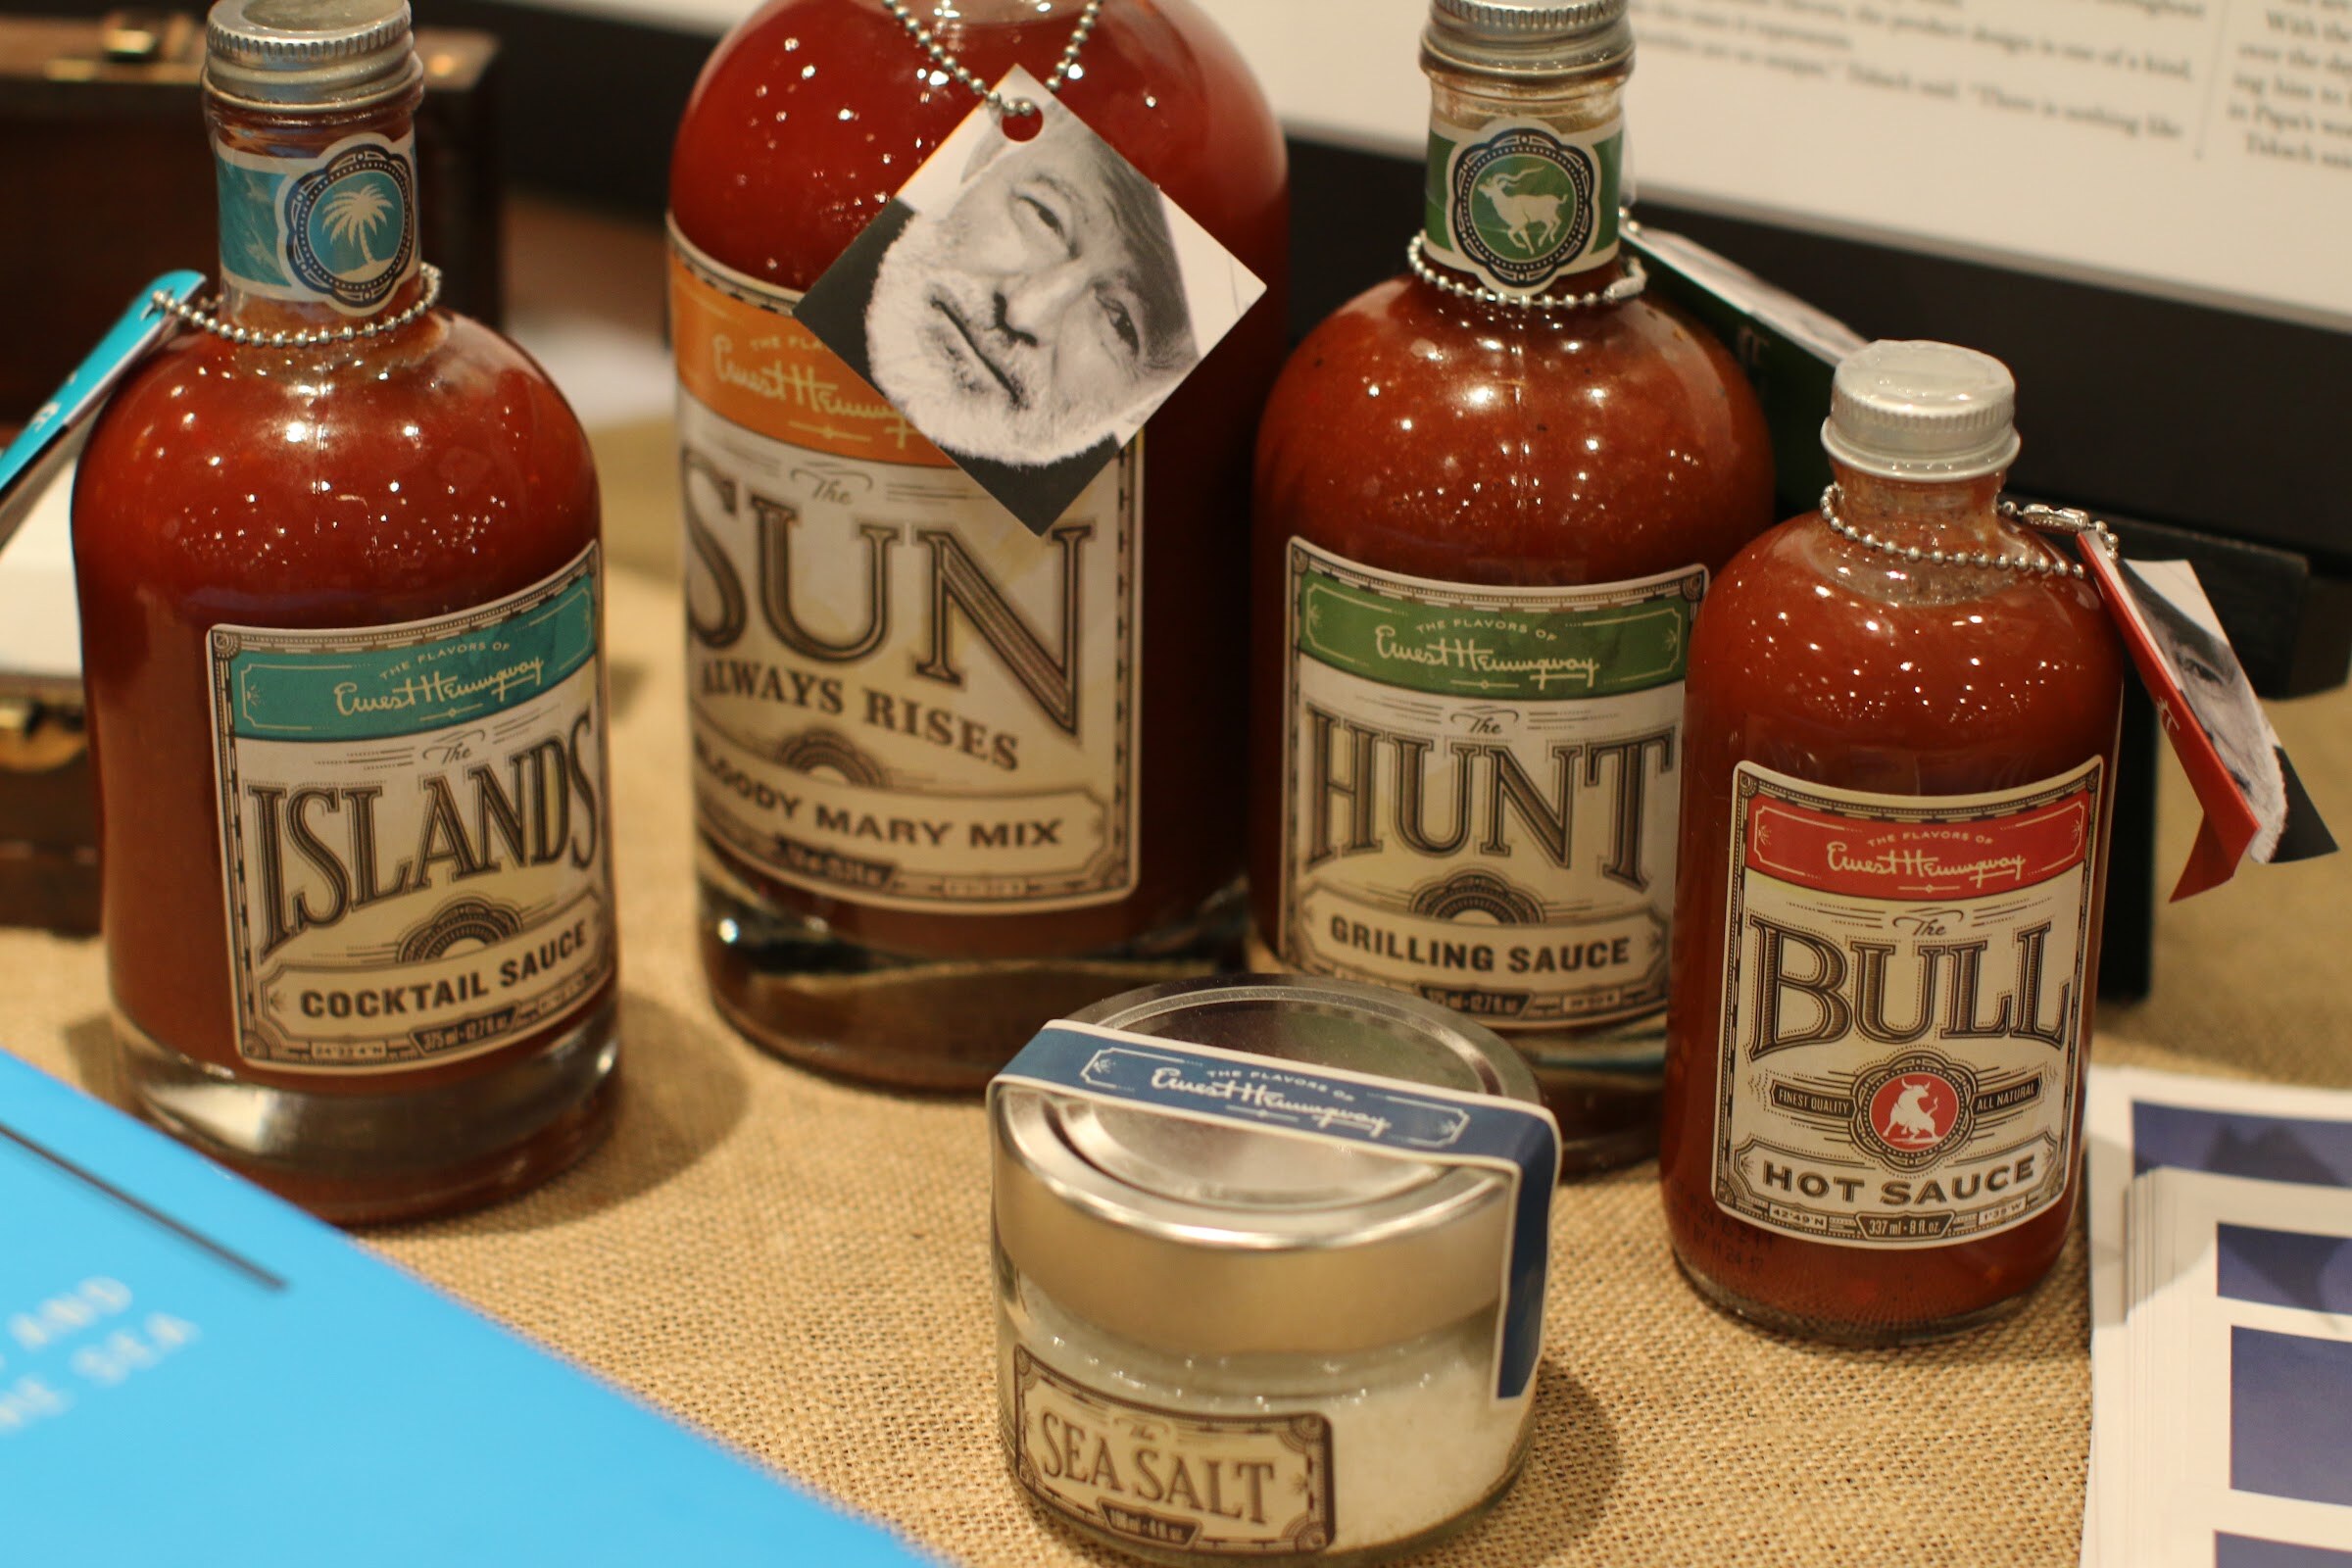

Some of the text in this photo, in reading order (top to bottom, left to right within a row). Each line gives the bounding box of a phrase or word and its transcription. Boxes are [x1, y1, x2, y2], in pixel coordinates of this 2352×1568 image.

[1415, 617, 1558, 642] THE FLAVORS OF
[378, 641, 511, 681] THE FLAVORS OF
[861, 686, 1020, 772] RISES
[1304, 701, 1679, 895] HUNT
[246, 708, 600, 964] ISLANDS
[814, 804, 954, 848] MARY
[967, 817, 1064, 849] MIX
[1867, 829, 1994, 848] THE FLAVORS OF
[300, 971, 490, 1019] COCKTAIL
[499, 918, 588, 988] SAUCE
[1329, 914, 1632, 974] GRILLING SAUCE
[1747, 917, 2071, 1063] BULL
[1250, 1069, 1329, 1094] FLAVORS
[1778, 1089, 1851, 1115] FINEST QUALITY
[1976, 1082, 2037, 1113] ALL NATURAL
[1763, 1153, 2036, 1207] HOT SAUCE
[1869, 1218, 1888, 1236] 337
[1041, 1410, 1125, 1493] SEA
[1134, 1446, 1276, 1526] SALT
